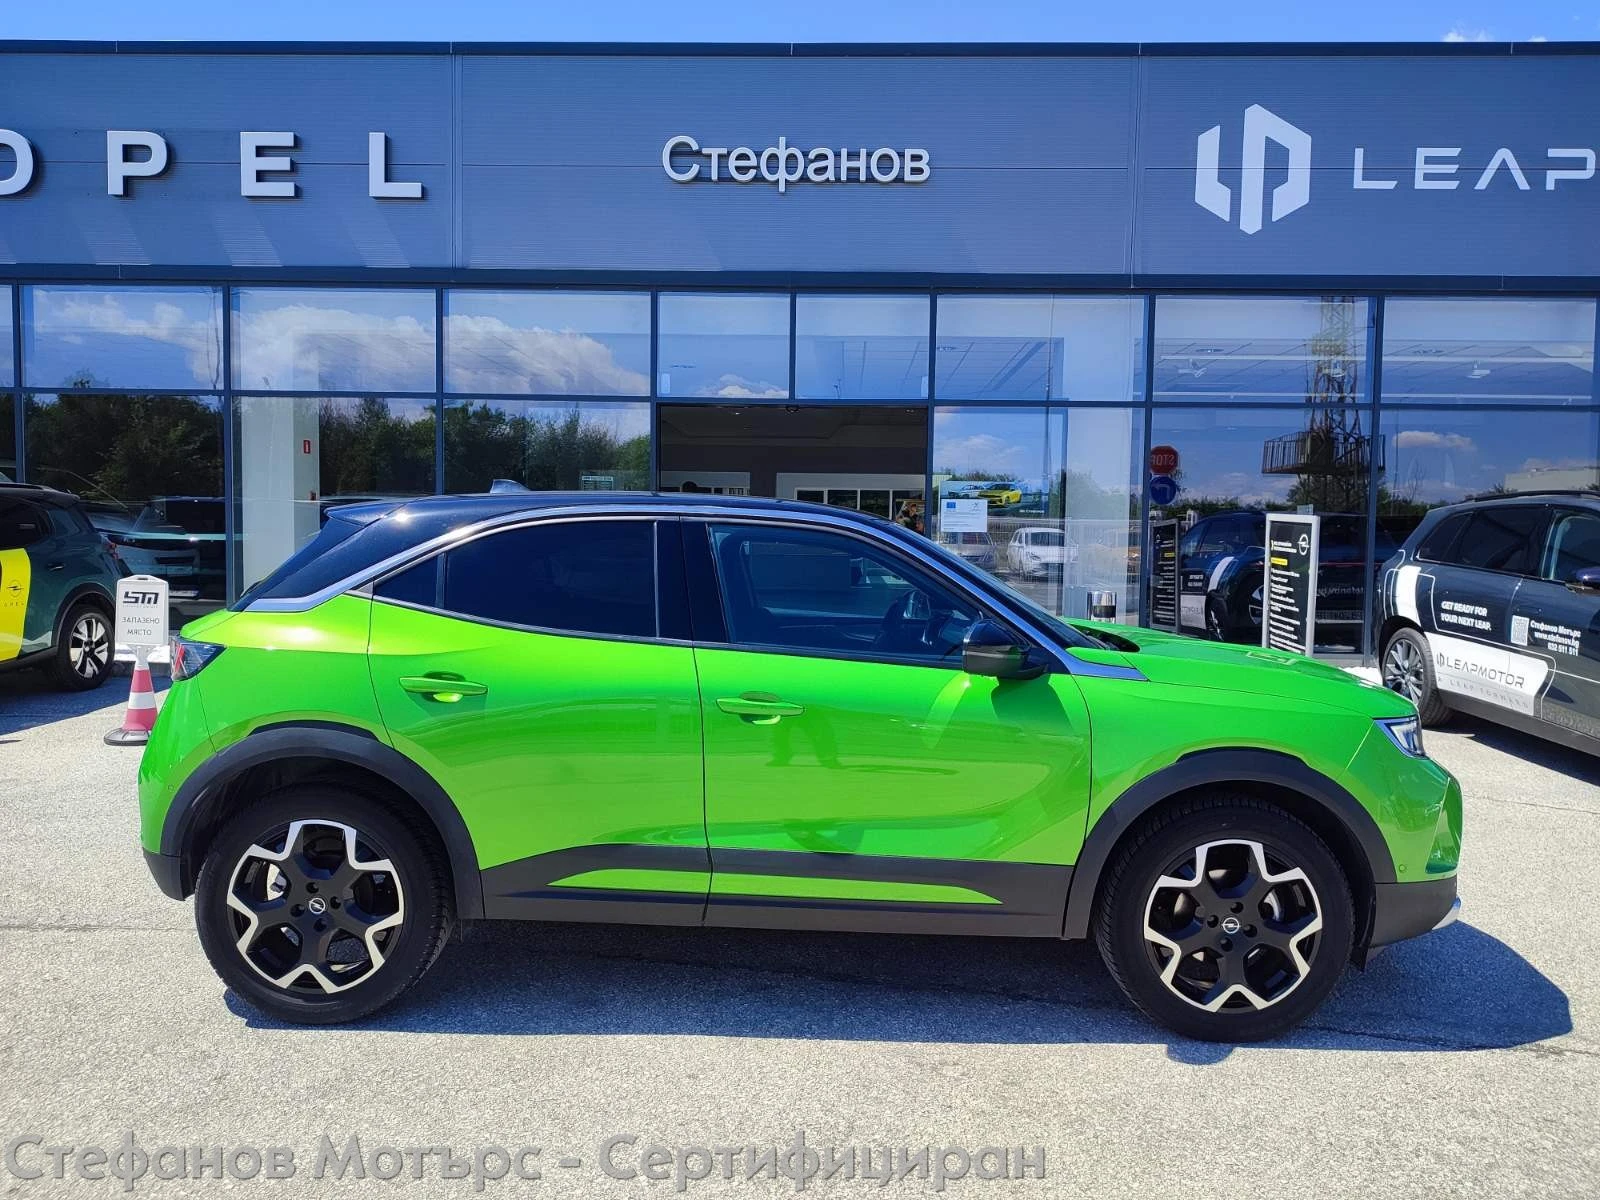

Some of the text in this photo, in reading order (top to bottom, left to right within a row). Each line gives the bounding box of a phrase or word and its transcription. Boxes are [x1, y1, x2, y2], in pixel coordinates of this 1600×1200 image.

[662, 135, 932, 193] Стефанов
[1353, 147, 1597, 191] LEAP
[121, 616, 160, 624] ЗАПАЗЕНО
[1440, 613, 1459, 624] YOUR
[1458, 615, 1475, 627] NEXT
[1454, 602, 1475, 615] READY
[1475, 605, 1488, 617] FOR
[1446, 657, 1525, 688] LEAPMOTOR
